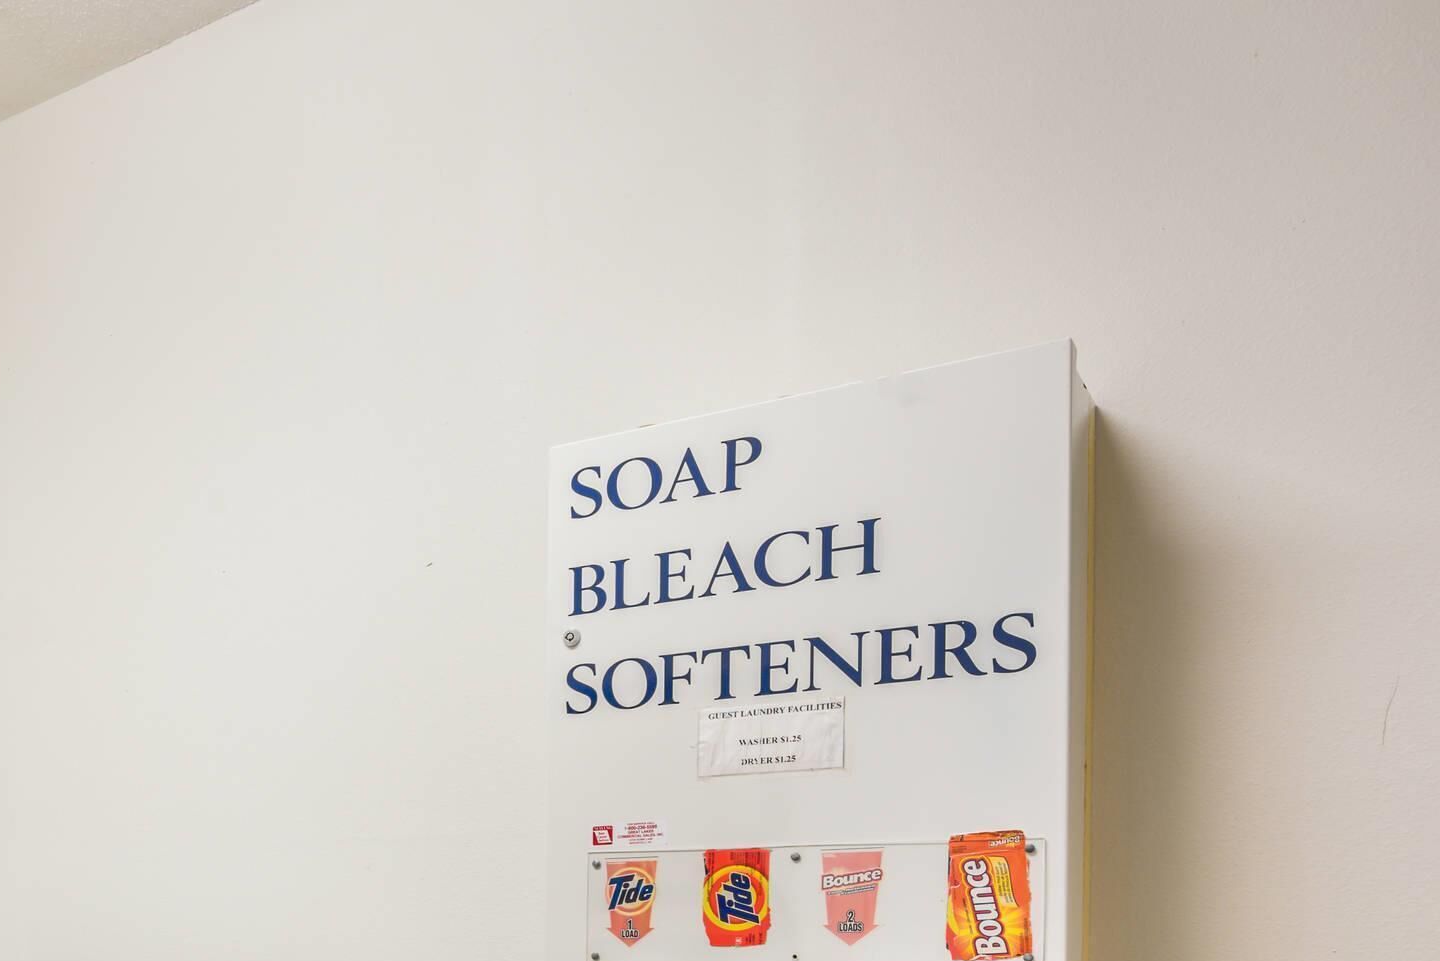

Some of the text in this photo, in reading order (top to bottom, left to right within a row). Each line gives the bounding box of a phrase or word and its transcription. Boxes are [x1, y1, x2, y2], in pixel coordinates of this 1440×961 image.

[570, 436, 763, 520] SOAP
[568, 517, 882, 617] BLEACH
[565, 612, 1038, 715] SOFTENERS
[708, 702, 842, 720] GUEST LAUNDRY FACILITIES
[739, 735, 802, 746] WASHER $1.25
[775, 755, 797, 764] $1.25
[822, 869, 882, 889] Bounce
[608, 874, 655, 911] Tide
[716, 872, 760, 924] Tide
[847, 911, 855, 922] 2
[963, 860, 1008, 954] Bounce
[621, 930, 639, 938] LOAD
[626, 919, 633, 930] 1
[839, 923, 863, 932] LOADS
